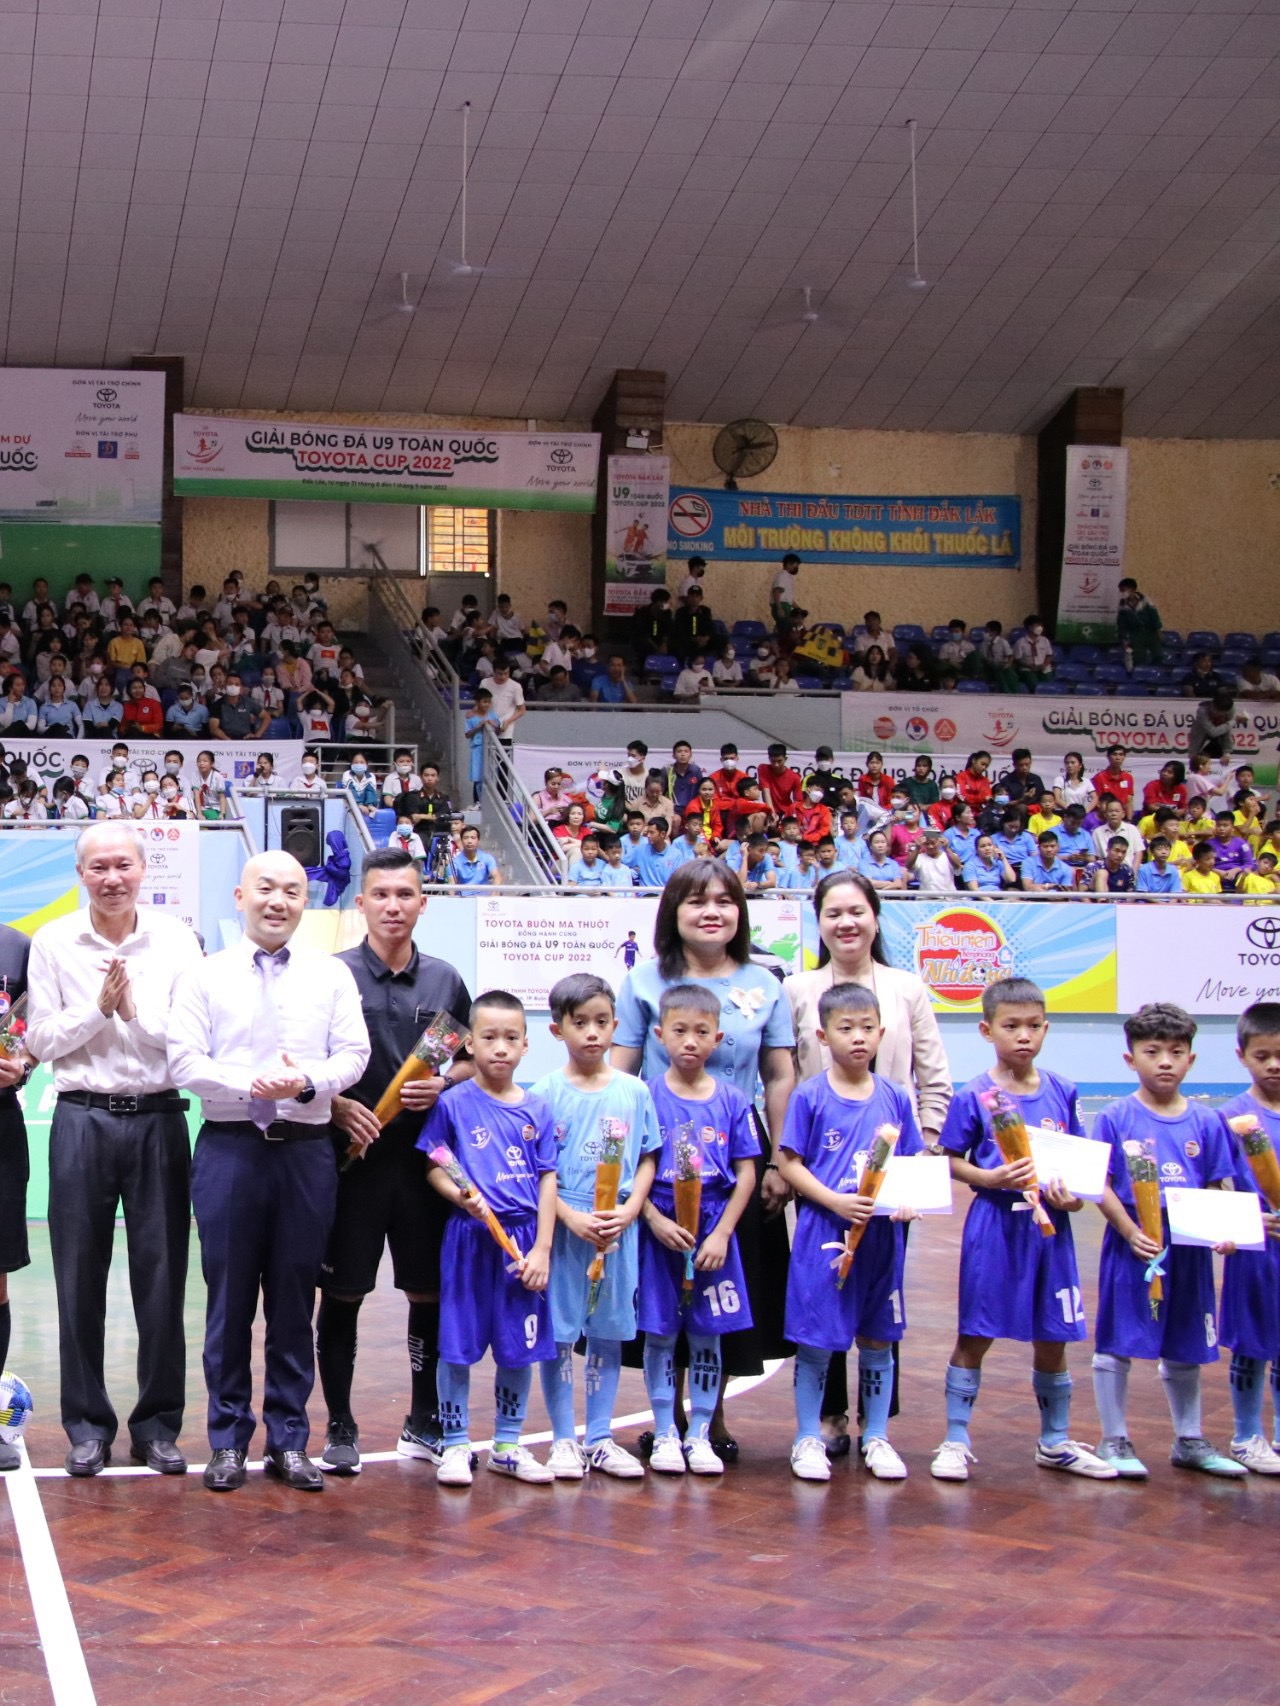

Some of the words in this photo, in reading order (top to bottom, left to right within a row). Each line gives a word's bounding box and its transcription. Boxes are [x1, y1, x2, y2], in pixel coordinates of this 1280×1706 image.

[251, 428, 284, 445] GIẢI
[291, 430, 338, 447] BÓNG
[343, 432, 367, 449] ĐÁ
[373, 437, 394, 450] U9
[399, 437, 443, 453] TOÀN
[449, 433, 496, 456] QUỐC
[298, 450, 367, 466] TOYOTA
[374, 453, 407, 468] CUP
[413, 456, 452, 470] 2022
[547, 465, 576, 473] TOYOTA
[526, 475, 550, 487] Move
[613, 487, 630, 498] U9
[738, 497, 771, 518] NHÀ
[777, 501, 803, 519] THI
[806, 496, 839, 520] ĐẤU
[844, 502, 884, 521] TDTT
[887, 499, 925, 522] TỈNH
[929, 499, 961, 524] ĐẮK
[965, 500, 997, 524] LẮK
[667, 540, 677, 551] NO
[679, 540, 714, 552] SMOKING
[723, 523, 755, 549] MÔI
[758, 523, 826, 552] TRƯỜNG
[828, 526, 887, 554] KHÔNG
[890, 526, 931, 555] KHÓI
[934, 525, 990, 556] THUỐC
[991, 528, 1013, 557] LÁ
[1049, 707, 1083, 725] GIẢI
[1089, 708, 1138, 727] BÓNG
[1143, 710, 1168, 728] ĐÁ
[1174, 714, 1195, 728] U9
[1096, 731, 1169, 747] TOYOTA
[486, 919, 523, 929] TOYOTA
[527, 919, 554, 929] BUÔN
[559, 920, 574, 929] MA
[578, 919, 610, 931] THUỘT
[480, 938, 499, 948] GIẢI
[501, 938, 527, 949] BÓNG
[530, 938, 542, 949] ĐÁ
[545, 940, 559, 949] U9
[562, 939, 585, 949] TOÀN
[588, 938, 616, 950] QUỐC
[503, 953, 541, 961] TOYOTA
[544, 953, 565, 961] CUP
[568, 953, 592, 962] 2022
[1238, 953, 1280, 966] TOYO
[1196, 978, 1251, 1003] Move
[702, 1279, 740, 1317] 16
[524, 1313, 538, 1350] 9
[409, 1334, 430, 1372] mitre
